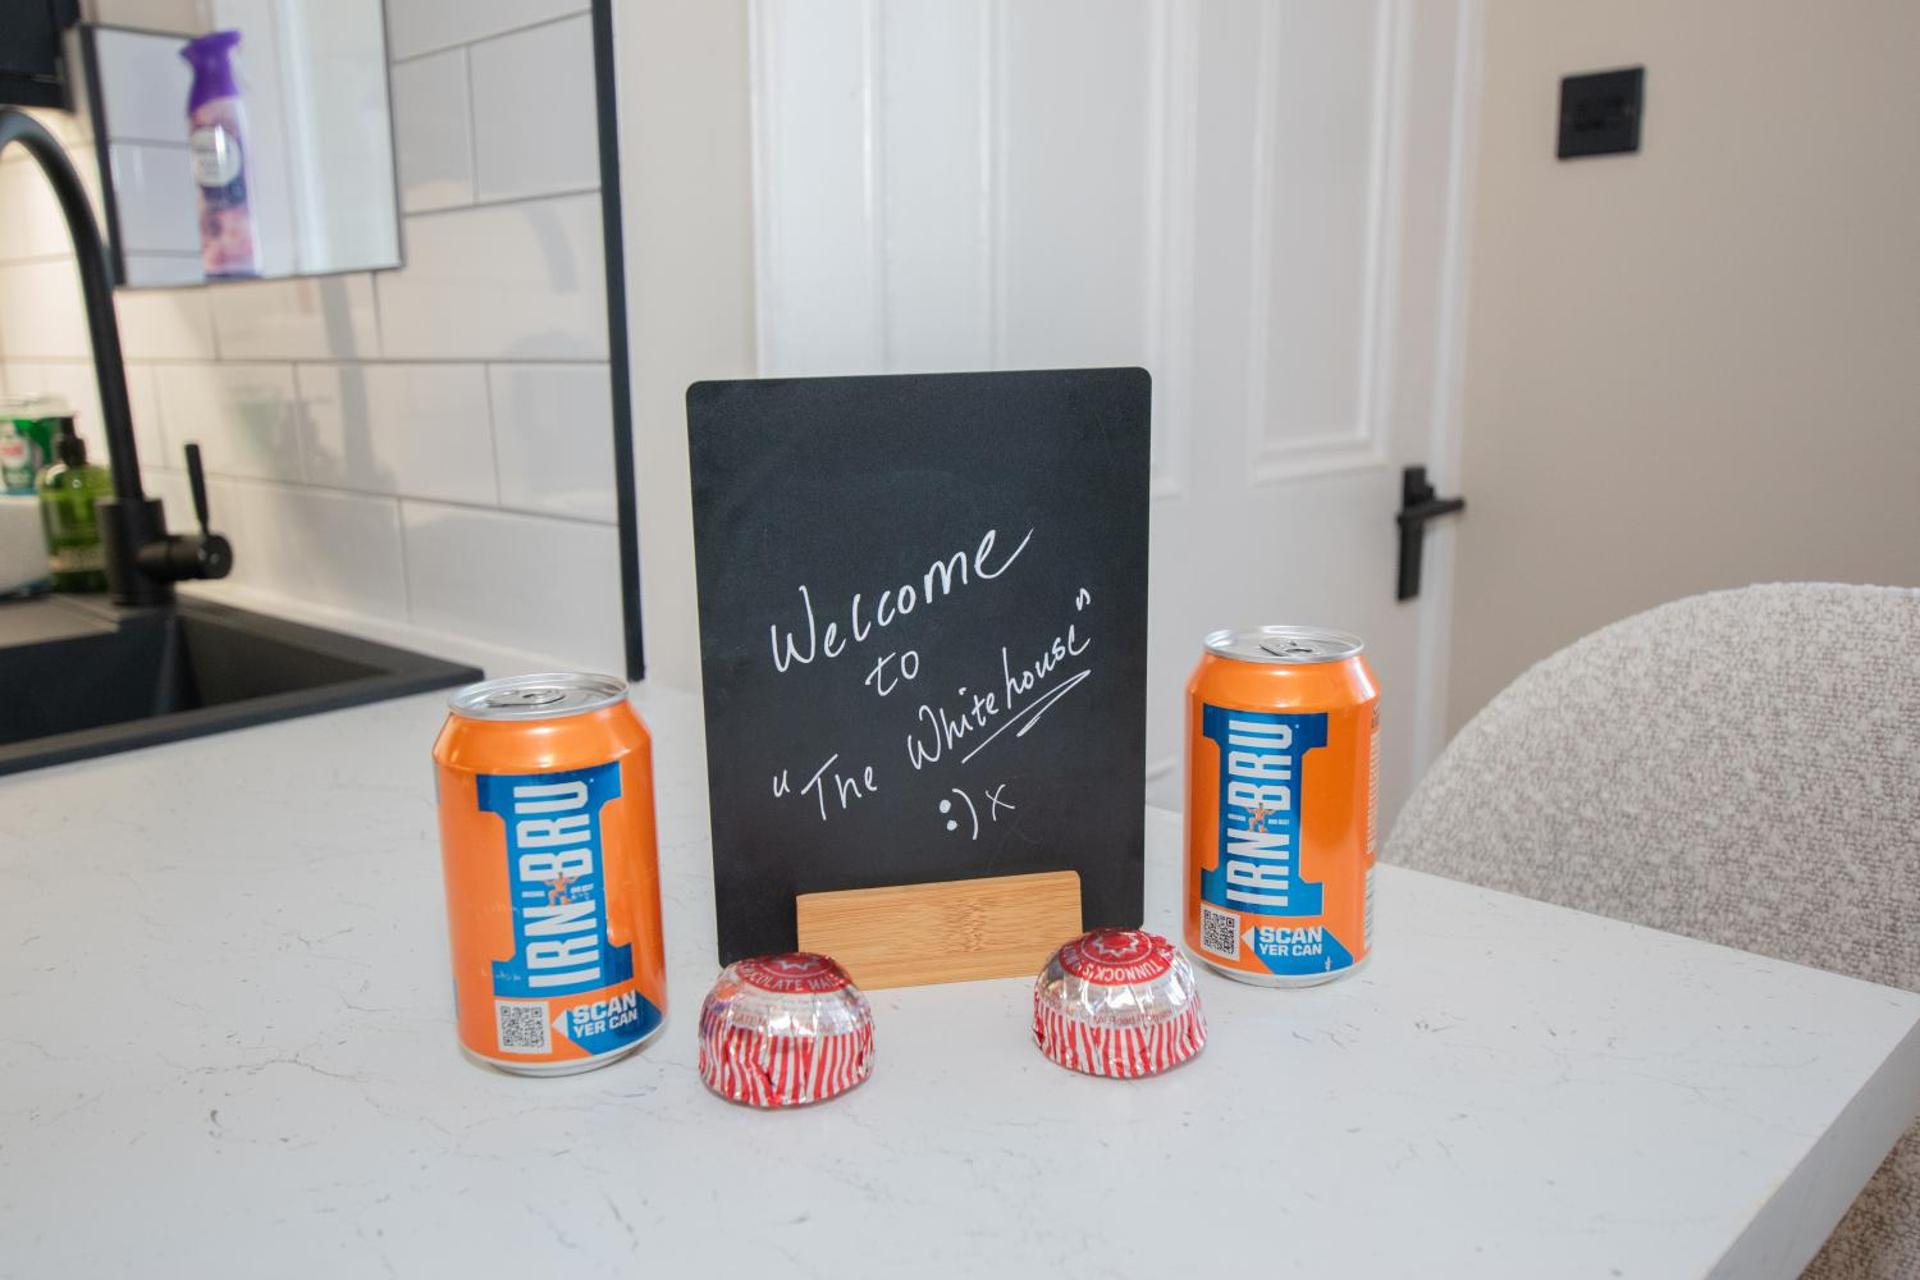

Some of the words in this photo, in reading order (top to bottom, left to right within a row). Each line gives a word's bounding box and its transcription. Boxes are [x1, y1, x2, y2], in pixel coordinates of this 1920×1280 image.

[771, 528, 1034, 673] Welcome
[864, 650, 921, 697] to
[1259, 926, 1323, 945] SCAN
[1259, 943, 1289, 957] YER
[1292, 943, 1323, 957] CAN
[1082, 958, 1165, 983] TUNNOCK'S
[572, 988, 638, 1025] SCAN
[573, 1020, 606, 1039] YER
[608, 1008, 638, 1031] CAN
